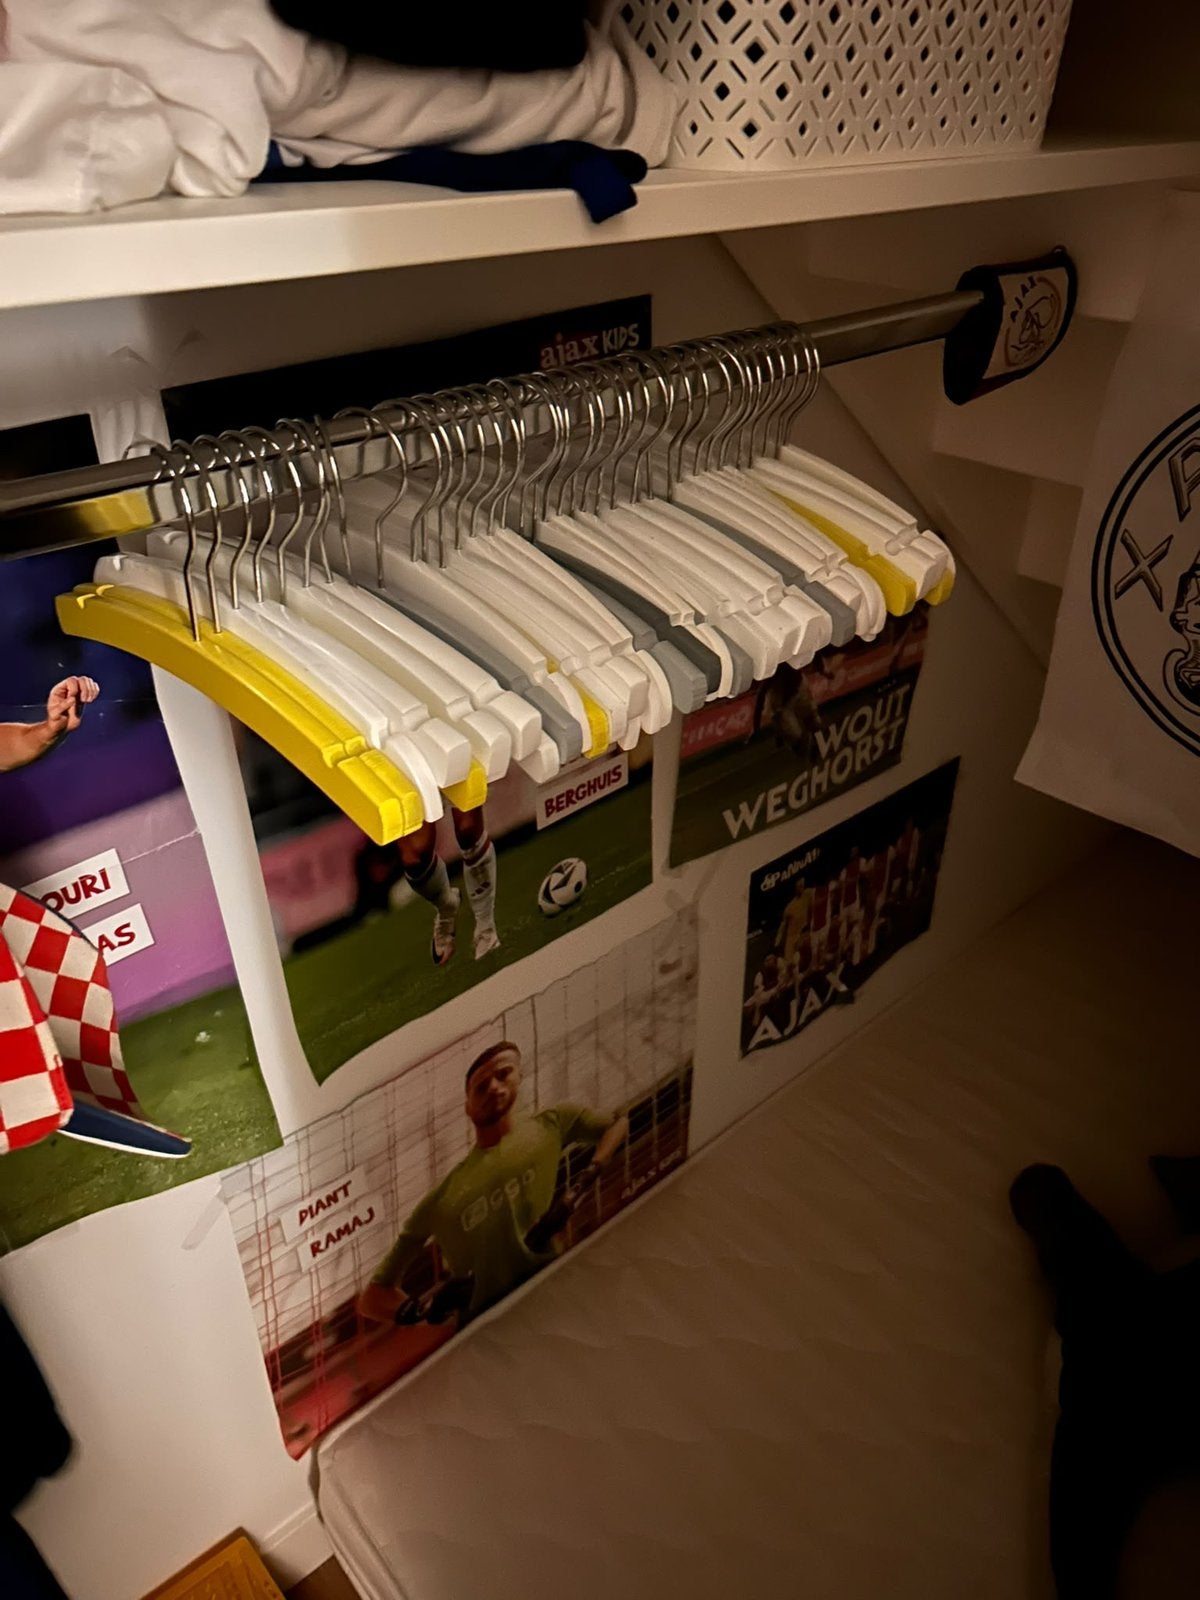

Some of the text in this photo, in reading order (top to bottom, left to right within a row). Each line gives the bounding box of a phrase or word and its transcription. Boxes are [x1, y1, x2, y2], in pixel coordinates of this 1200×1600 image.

[540, 323, 640, 368] ajax KIDS
[814, 684, 910, 759] WOUT
[544, 765, 622, 818] BERGHUIS
[722, 716, 904, 839] WEGHORST
[40, 868, 111, 912] OURI
[98, 922, 136, 951] AS
[748, 962, 848, 1049] AJAX
[298, 1180, 352, 1226] DIANT
[310, 1207, 375, 1258] RAMAJ
